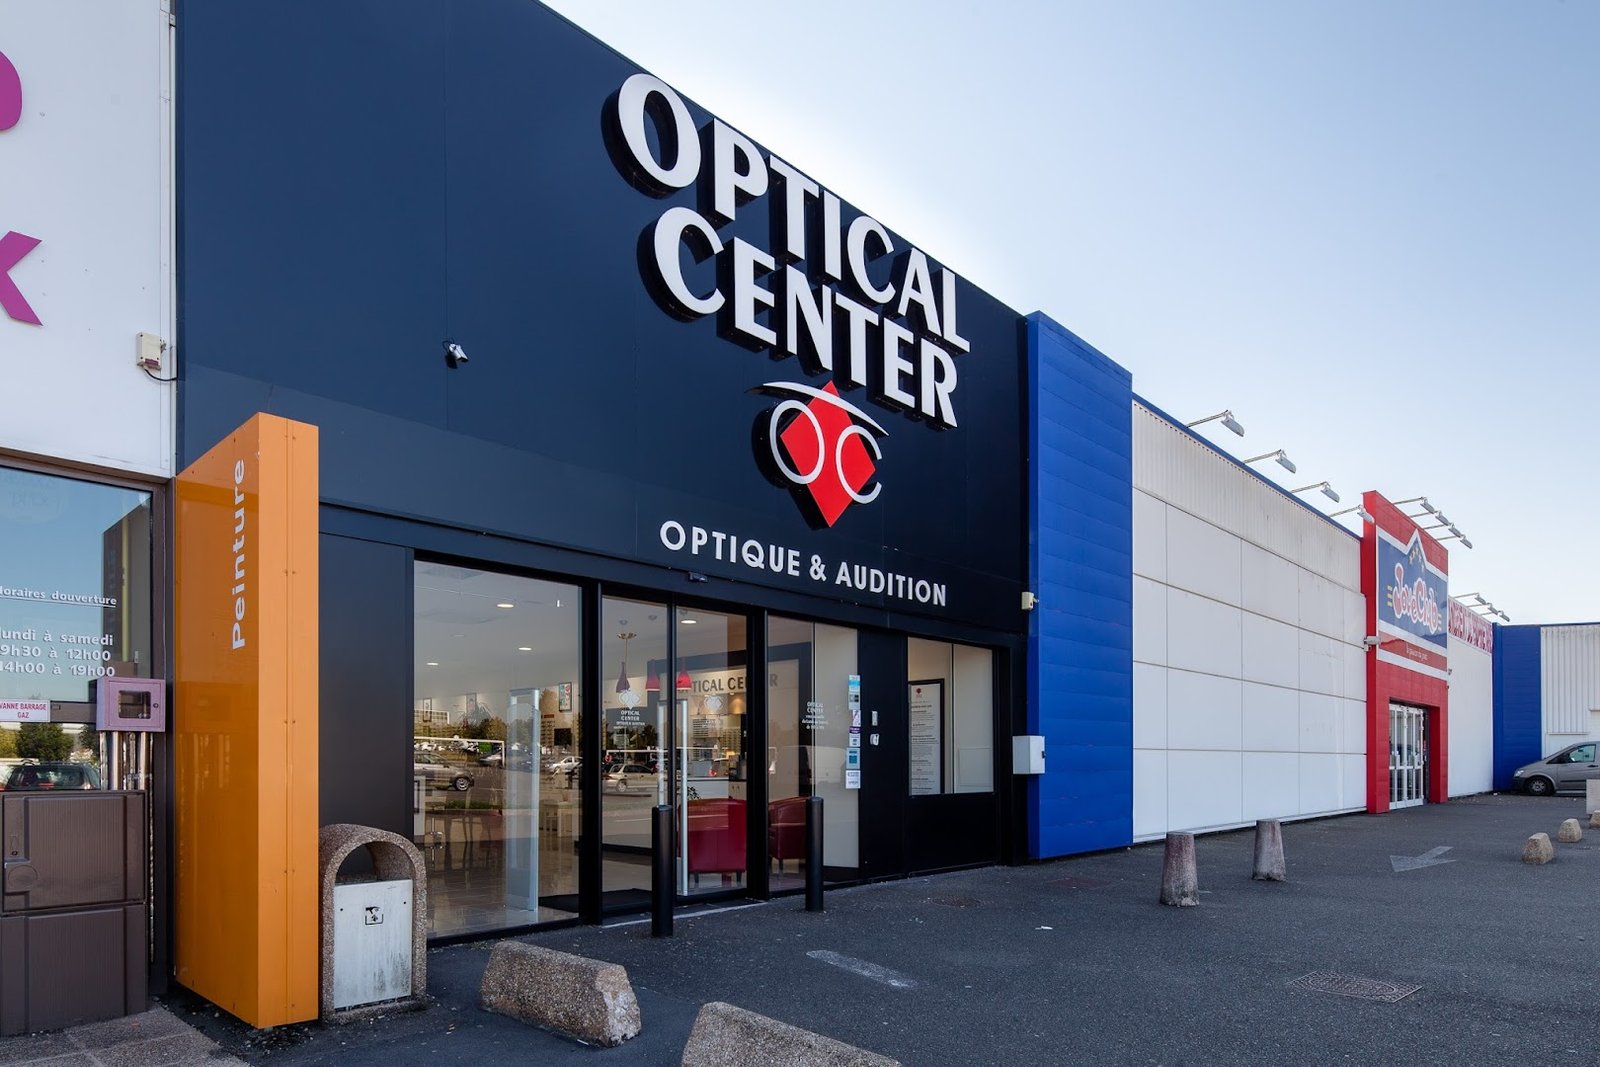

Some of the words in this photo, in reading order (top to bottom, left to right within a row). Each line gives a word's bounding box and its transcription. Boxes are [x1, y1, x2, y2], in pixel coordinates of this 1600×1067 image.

[615, 73, 971, 353] OPTICAL
[652, 206, 958, 428] CENTER
[232, 459, 246, 650] Peinture
[660, 520, 801, 577] OPTIQUE
[808, 554, 827, 582] &
[835, 561, 947, 607] AUDITION
[43, 630, 52, 642] à
[60, 633, 114, 646] samedi
[0, 644, 41, 657] 9h30
[50, 647, 58, 659] à
[66, 650, 112, 662] 12h00
[53, 663, 62, 675] à
[71, 664, 115, 677] 19h00
[17, 711, 30, 719] GAZ
[20, 702, 47, 711] BARRAGE
